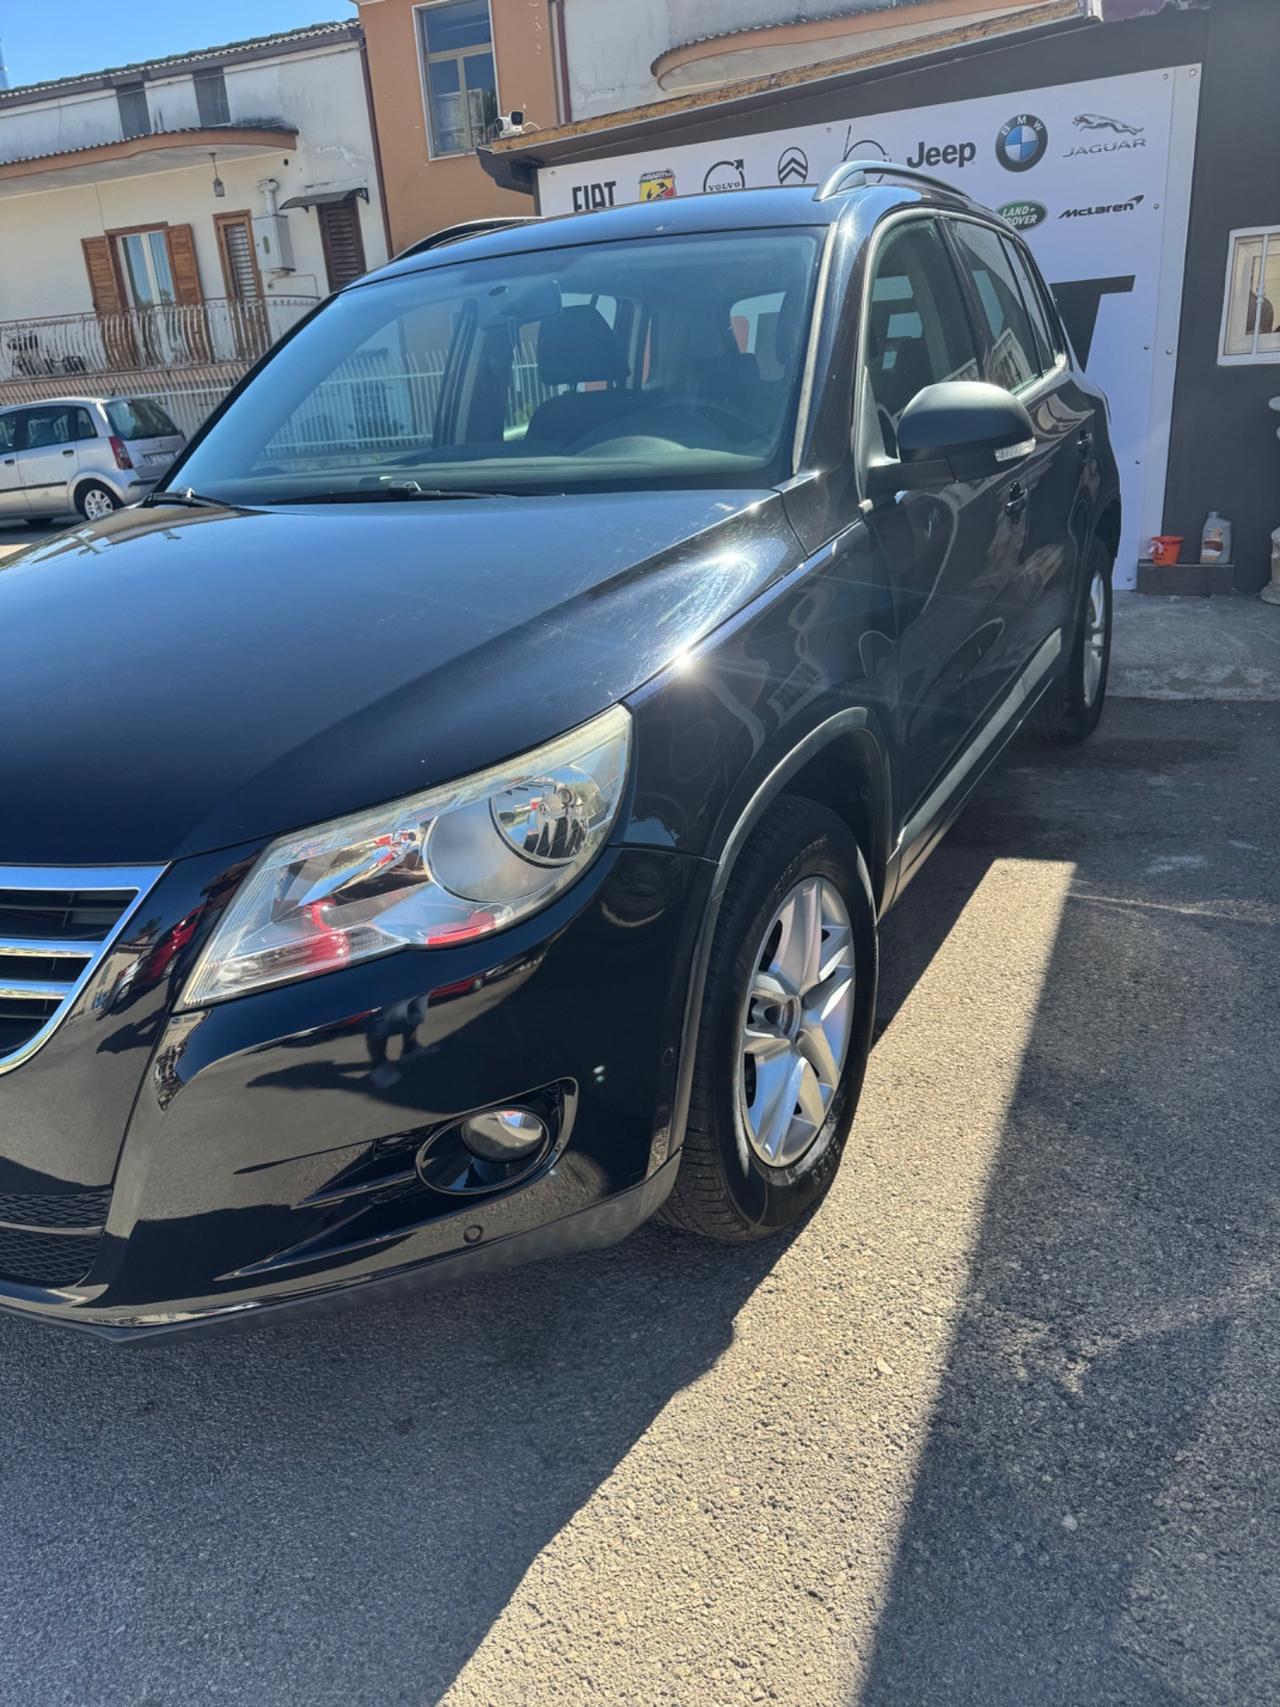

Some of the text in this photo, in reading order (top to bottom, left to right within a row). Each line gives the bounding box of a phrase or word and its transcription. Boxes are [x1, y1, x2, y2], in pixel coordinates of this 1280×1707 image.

[1001, 115, 1043, 136] BMW
[906, 141, 976, 168] Jeep
[1062, 138, 1147, 158] JAGUAR
[572, 181, 616, 212] FIAT
[707, 181, 741, 192] VOLVO
[1058, 202, 1135, 219] McLaren
